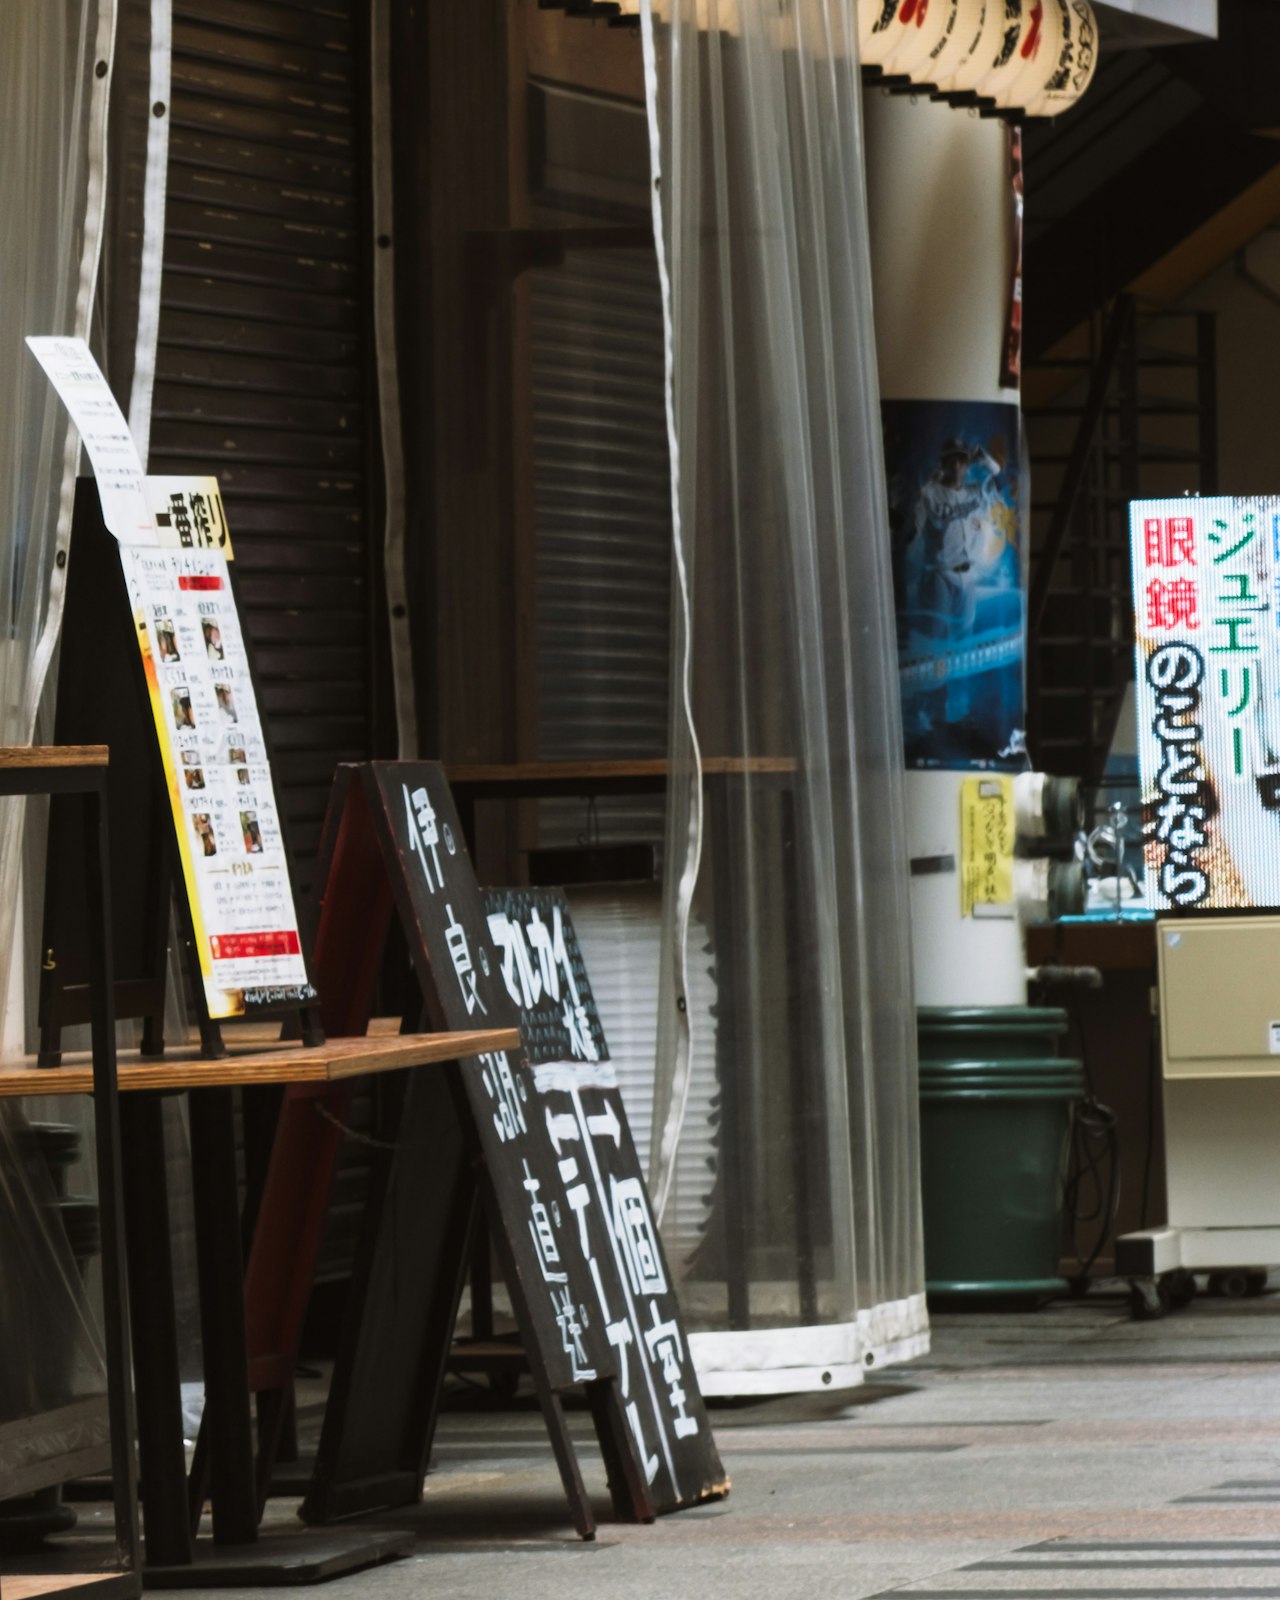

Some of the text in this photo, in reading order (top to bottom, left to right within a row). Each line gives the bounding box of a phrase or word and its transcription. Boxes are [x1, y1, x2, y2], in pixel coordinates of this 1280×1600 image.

[155, 491, 227, 549] 一番搾り
[1207, 512, 1259, 779] ジュエリー
